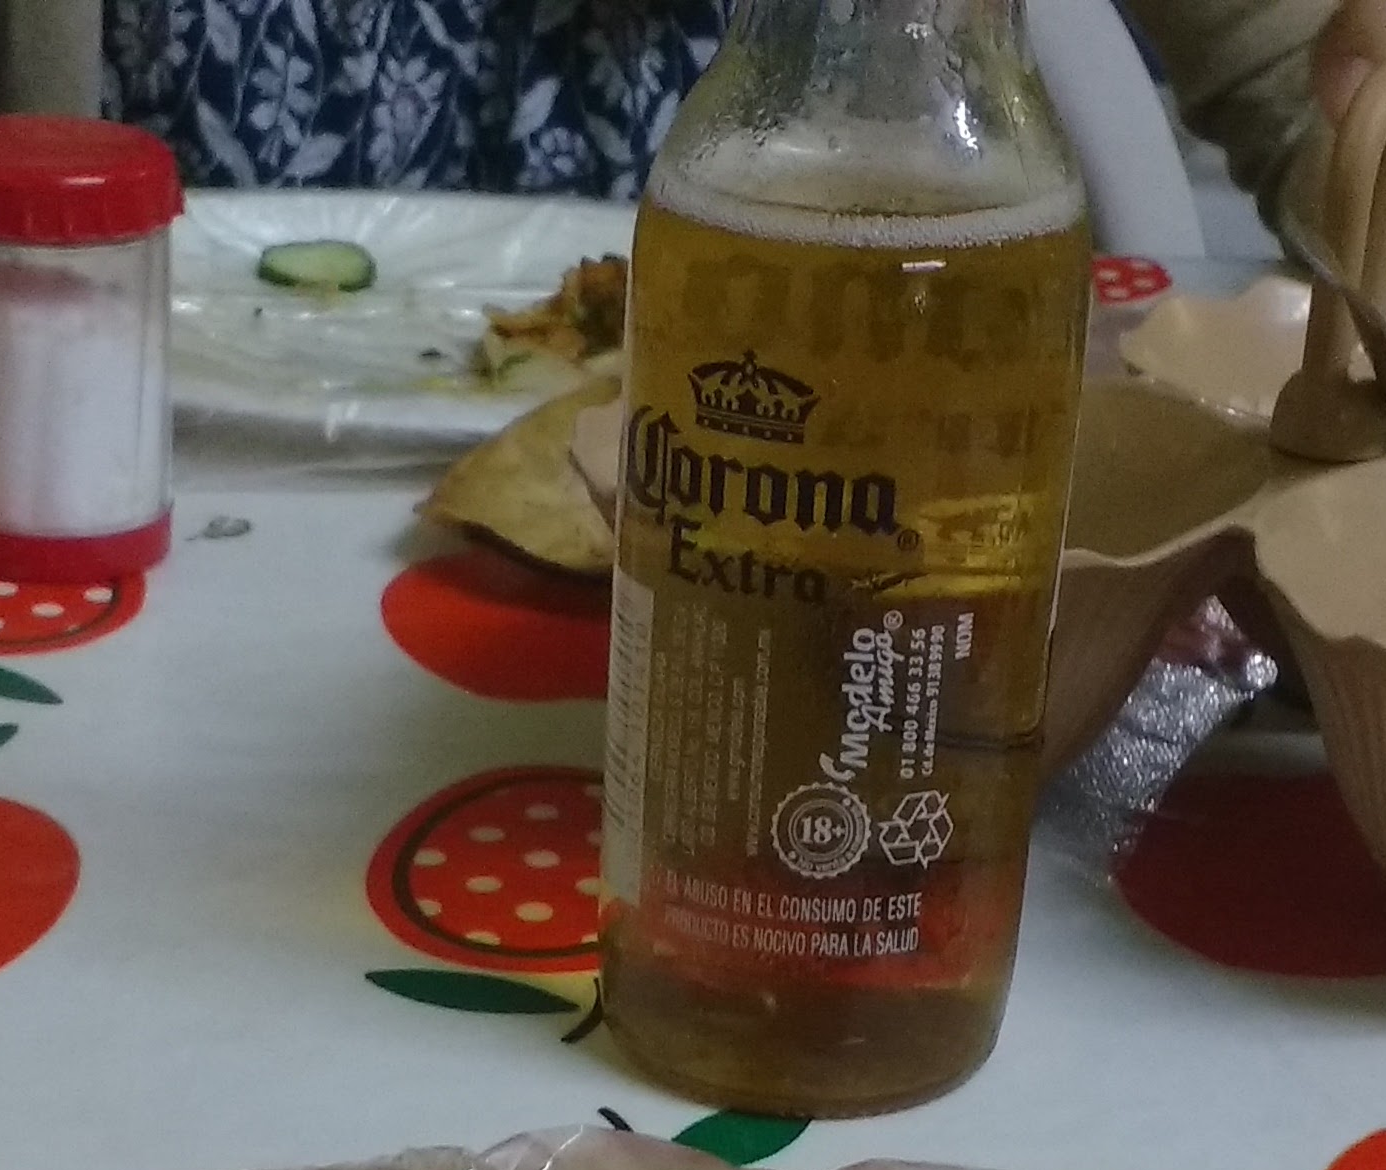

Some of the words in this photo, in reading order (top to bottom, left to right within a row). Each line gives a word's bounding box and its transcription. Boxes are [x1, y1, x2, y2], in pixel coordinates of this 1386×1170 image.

[627, 404, 900, 536] Corona
[668, 514, 827, 603] Extra
[954, 612, 975, 661] NOM
[861, 630, 905, 733] Amigo
[907, 654, 925, 679] 33
[839, 627, 876, 769] Modelo
[901, 718, 920, 754] 800
[898, 758, 915, 780] 01
[683, 875, 728, 909] ABUSO
[733, 887, 752, 914] EN
[757, 892, 774, 917] EL
[779, 894, 857, 923] CONSUMO
[862, 897, 883, 921] DE
[887, 892, 923, 920] ESTE
[732, 924, 749, 949] ES
[753, 926, 806, 956] NOCIVO
[810, 931, 849, 957] PARA
[853, 931, 872, 957] LA
[875, 926, 920, 955] SALUD
